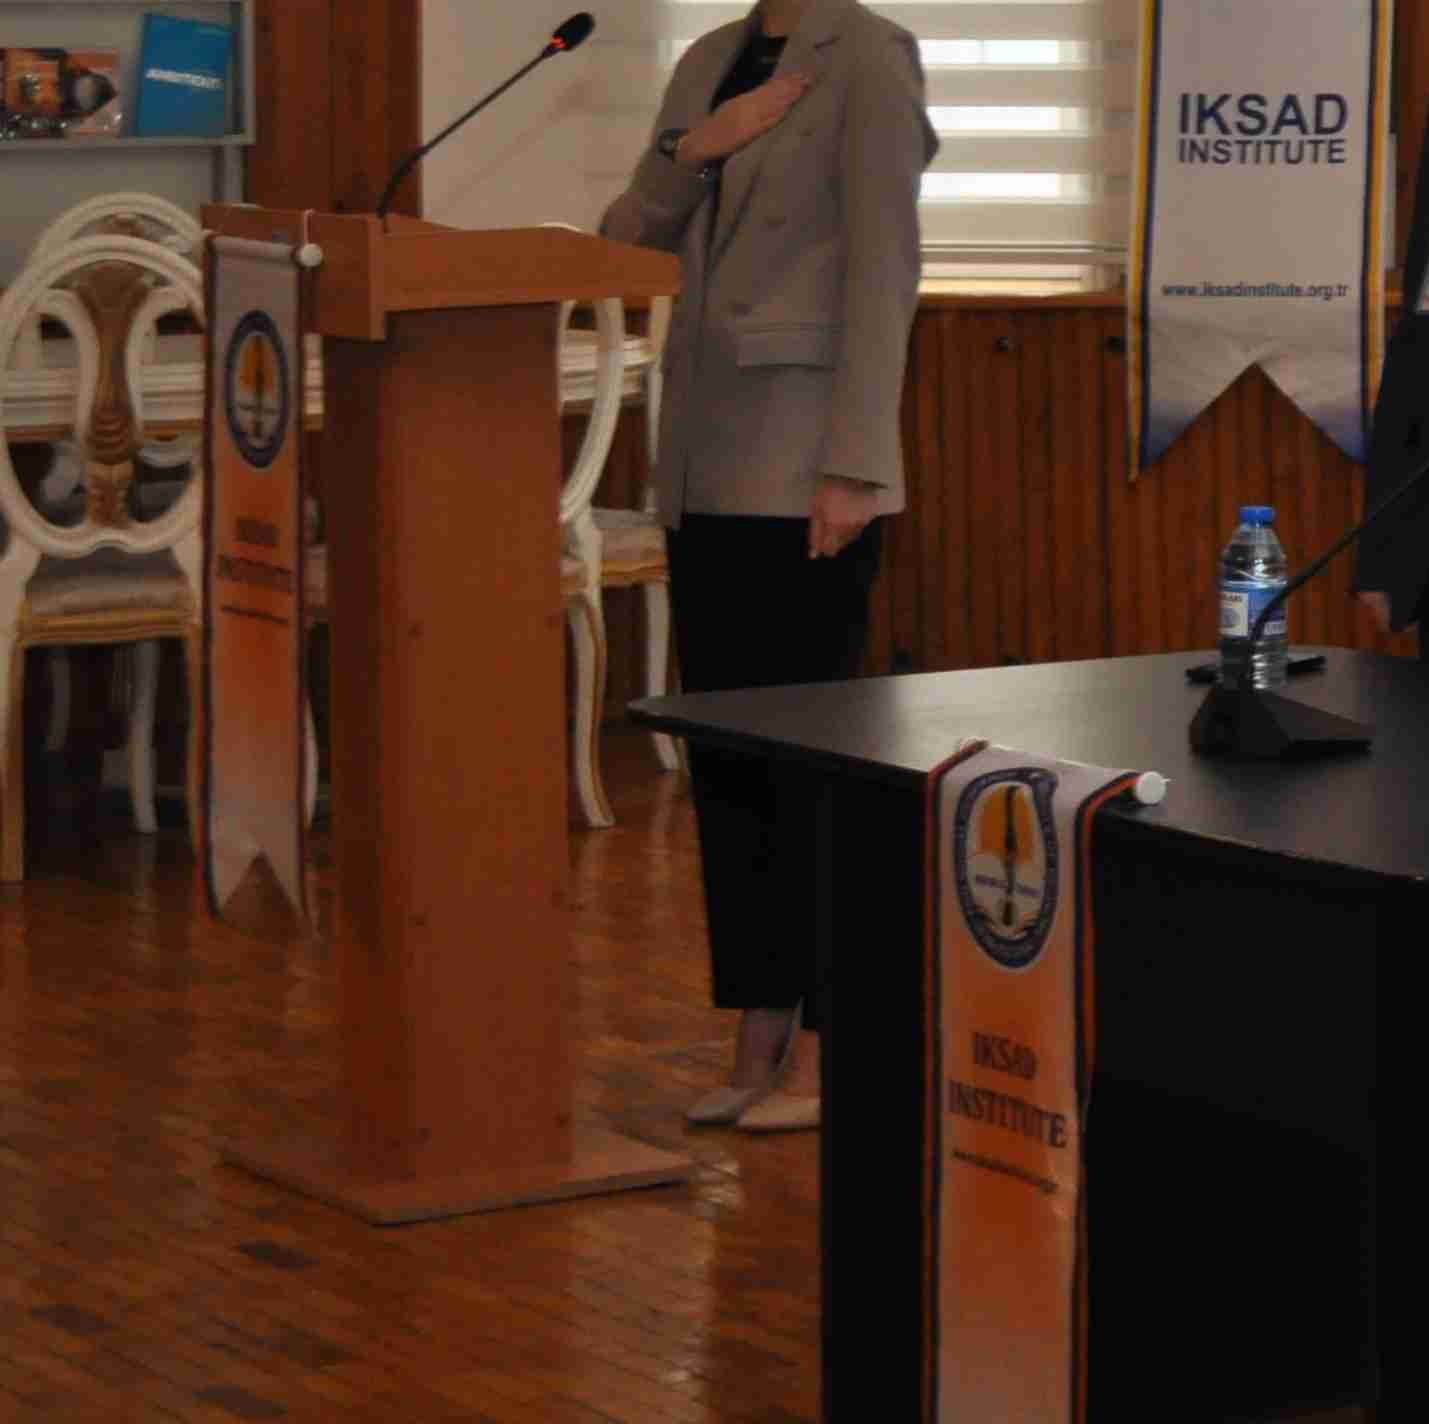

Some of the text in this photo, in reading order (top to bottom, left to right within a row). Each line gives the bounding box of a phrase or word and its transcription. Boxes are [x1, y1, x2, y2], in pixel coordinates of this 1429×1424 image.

[1179, 93, 1348, 136] IKSAD
[1178, 139, 1347, 164] INSTITUTE
[948, 1079, 1068, 1148] INSTITUTE
